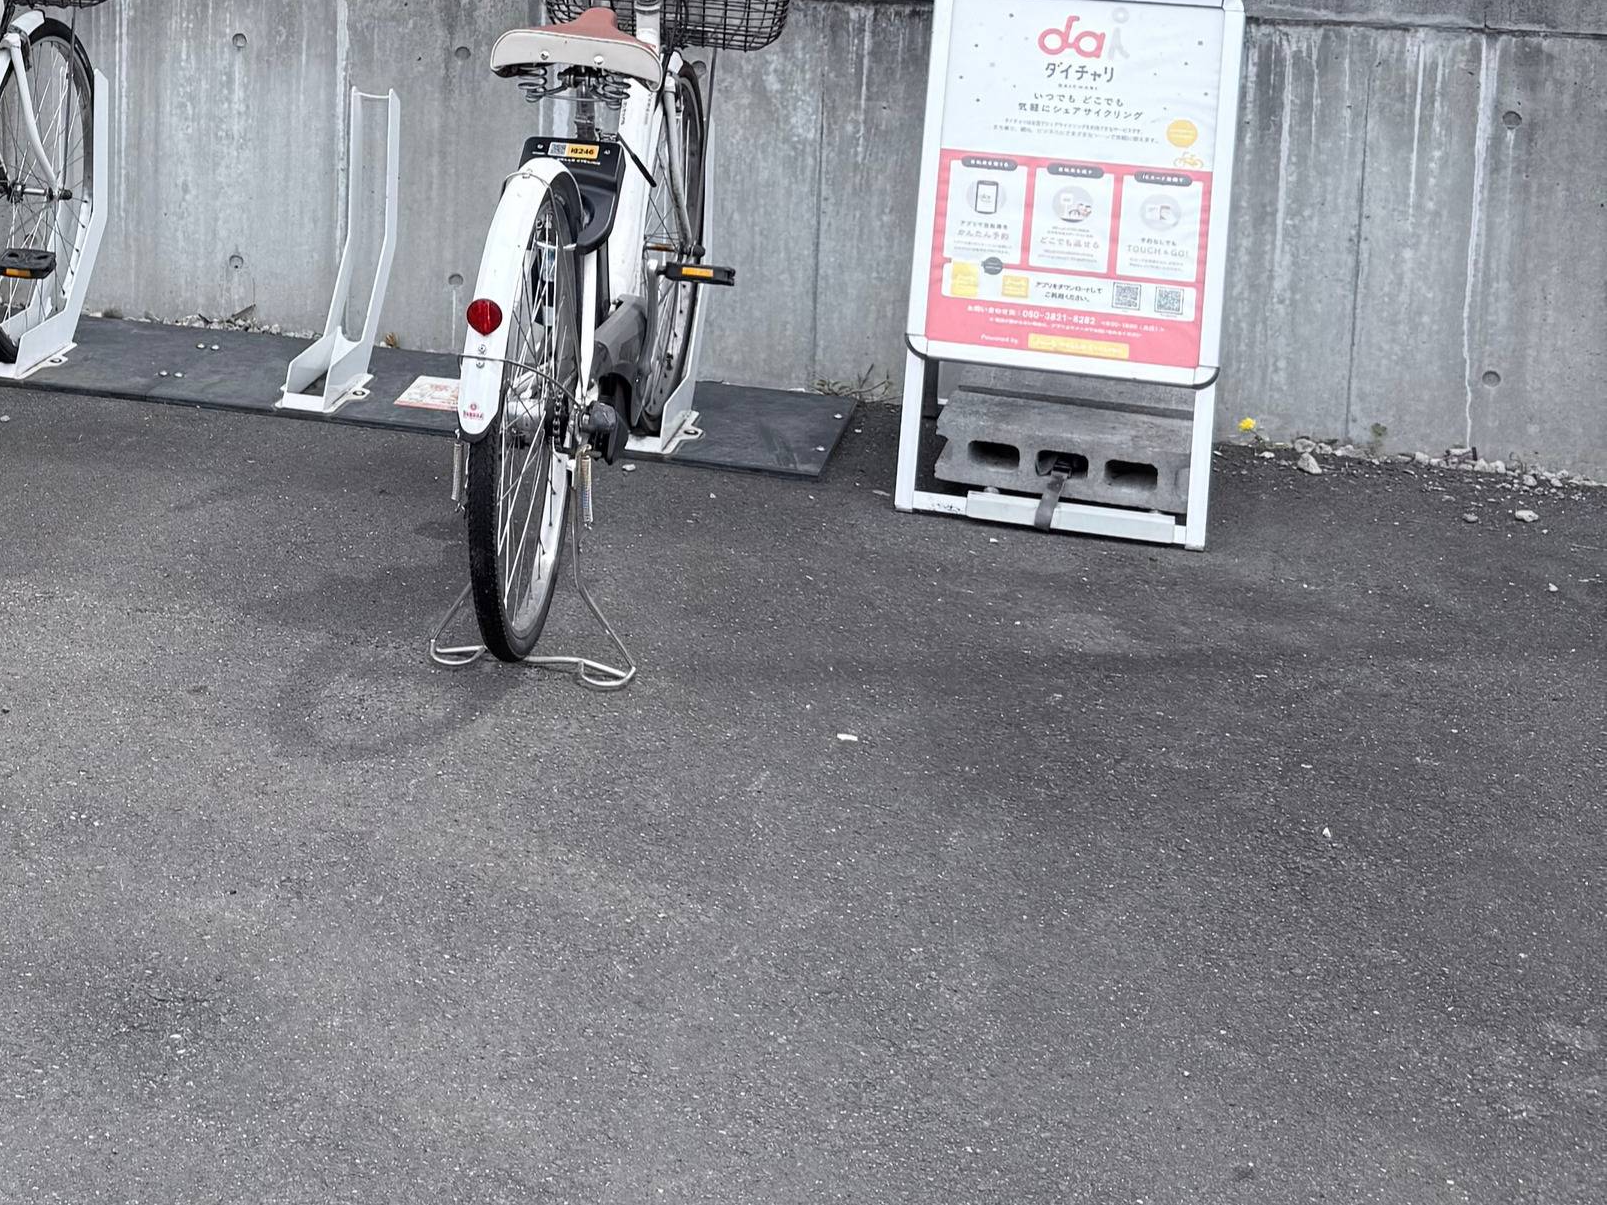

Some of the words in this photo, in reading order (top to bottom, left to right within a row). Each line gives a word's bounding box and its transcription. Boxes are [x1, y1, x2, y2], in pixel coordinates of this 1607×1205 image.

[1045, 62, 1115, 83] ダイチャリ
[1033, 93, 1076, 104] いつでも
[1082, 95, 1125, 108] どこでも
[1018, 102, 1144, 121] 気軽にシェアサイクリング
[1127, 245, 1162, 256] TOUCH
[1170, 249, 1190, 259] GO!
